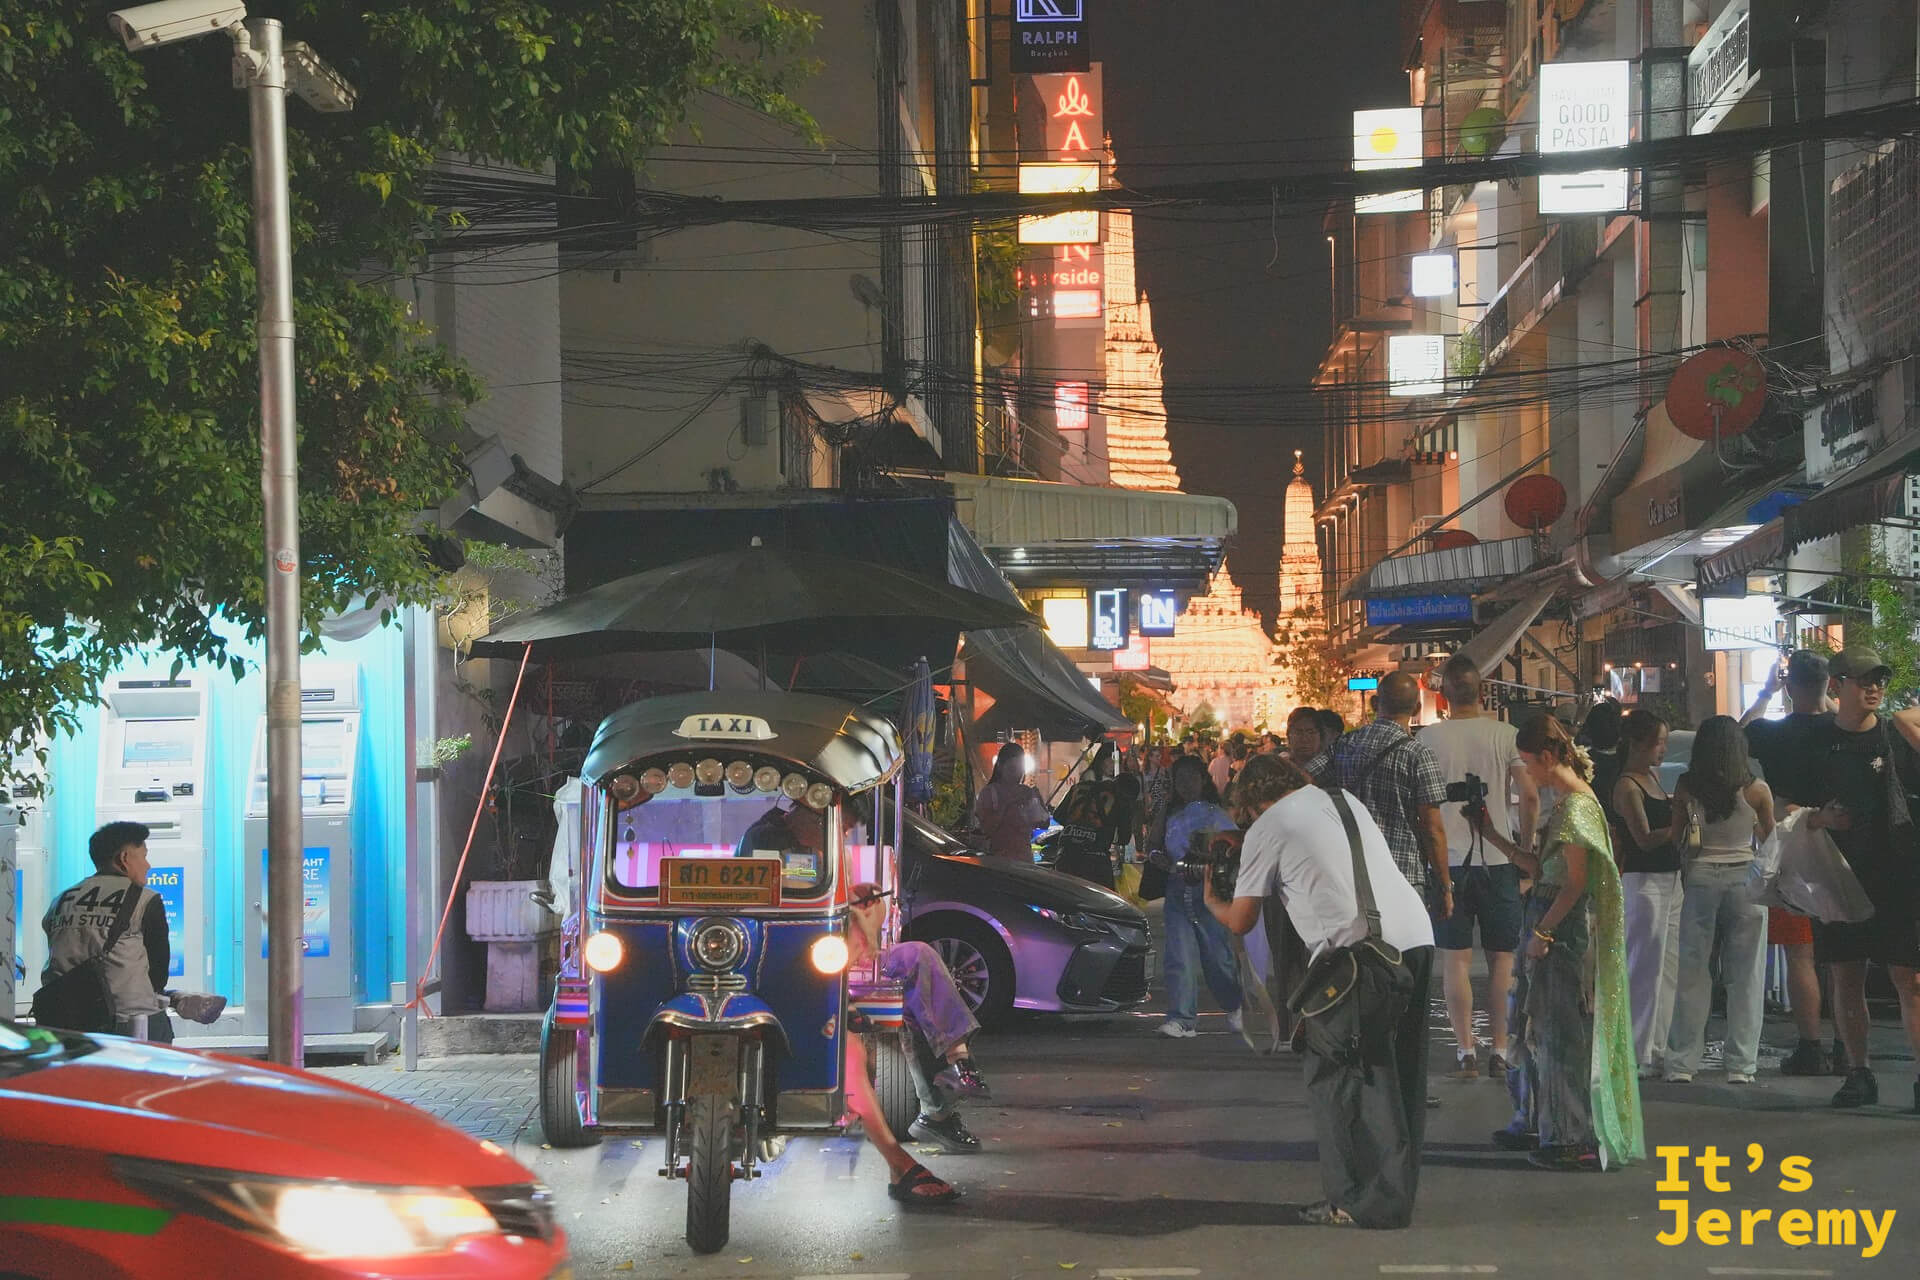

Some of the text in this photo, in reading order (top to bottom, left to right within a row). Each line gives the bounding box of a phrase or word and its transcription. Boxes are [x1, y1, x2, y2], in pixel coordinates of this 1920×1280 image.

[1022, 31, 1078, 45] RALPH
[1559, 103, 1610, 124] GOOD
[1552, 126, 1616, 148] PASTA!
[1708, 623, 1774, 645] KITCHEN
[697, 718, 753, 733] TAXI
[719, 865, 769, 885] 6247
[54, 886, 126, 916] F44
